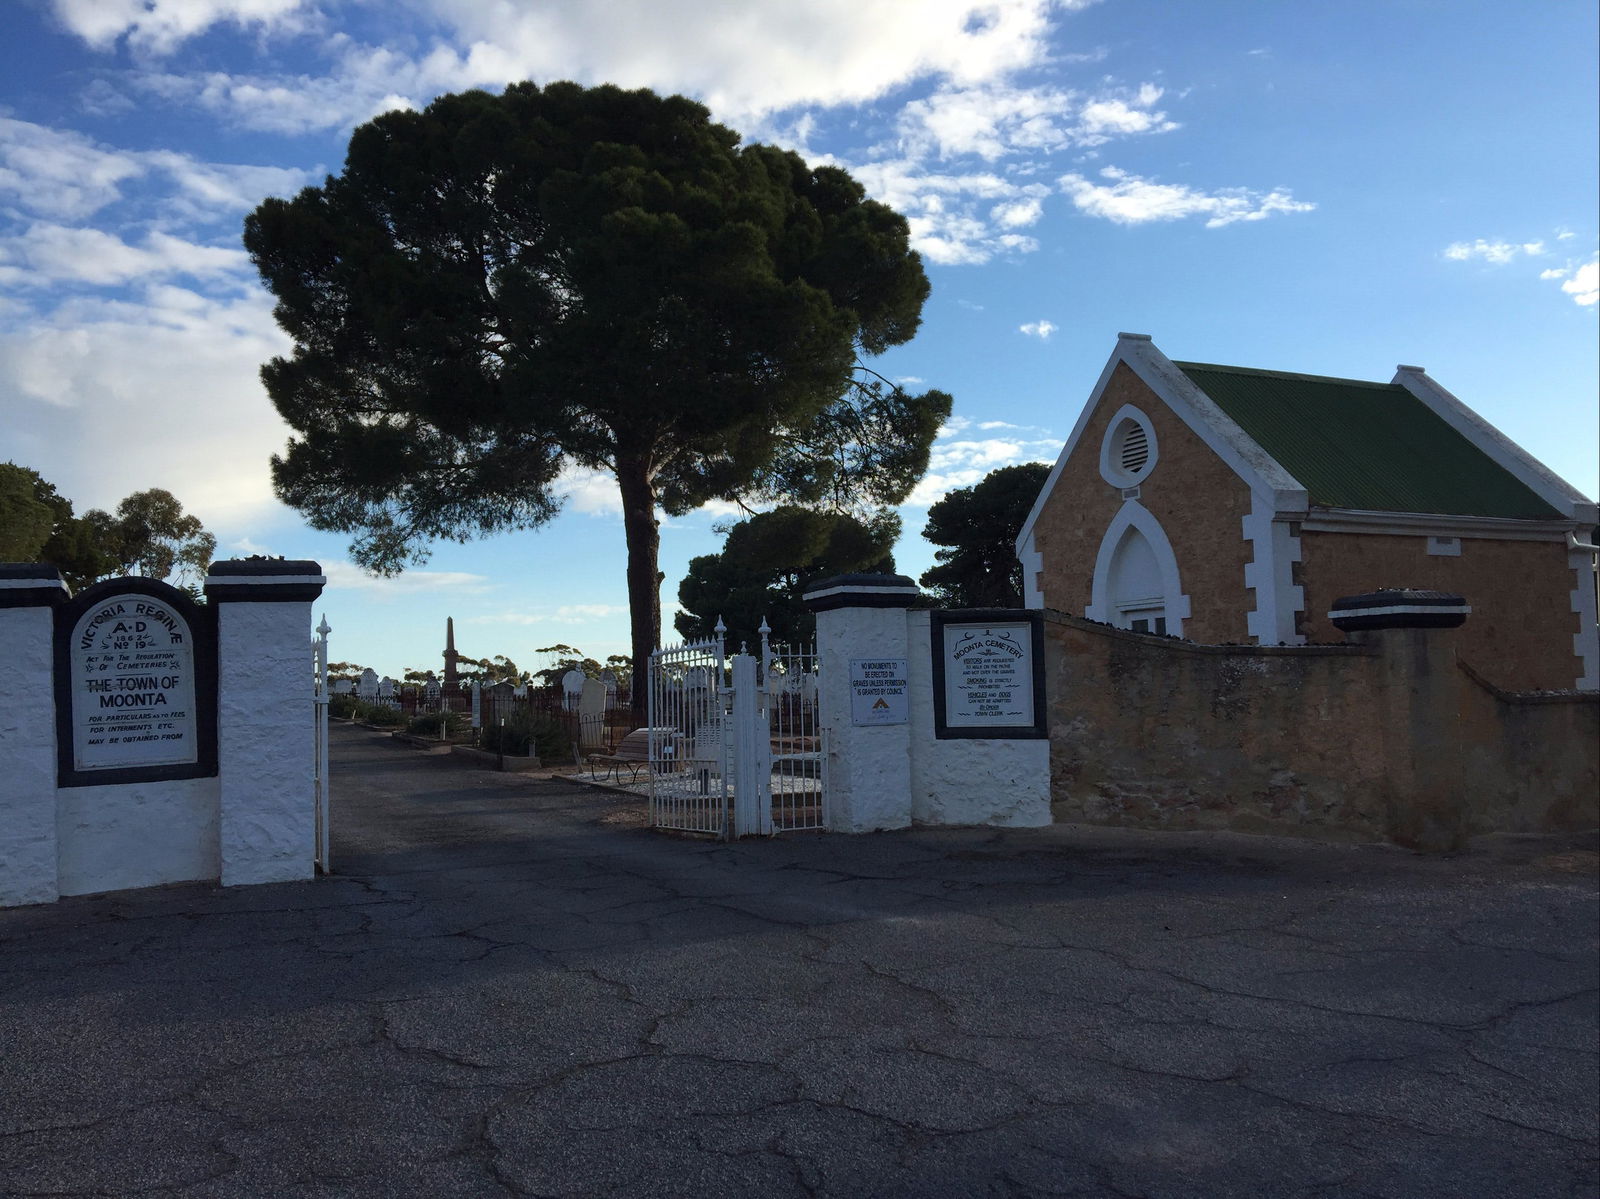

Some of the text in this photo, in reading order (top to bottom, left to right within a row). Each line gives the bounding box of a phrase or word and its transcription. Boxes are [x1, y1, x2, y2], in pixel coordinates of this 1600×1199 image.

[81, 604, 125, 649] VICTORIA
[954, 640, 1023, 660] MOONTA CEMETERY
[86, 676, 179, 693] THE TOWN OF
[100, 693, 167, 708] MOONTA
